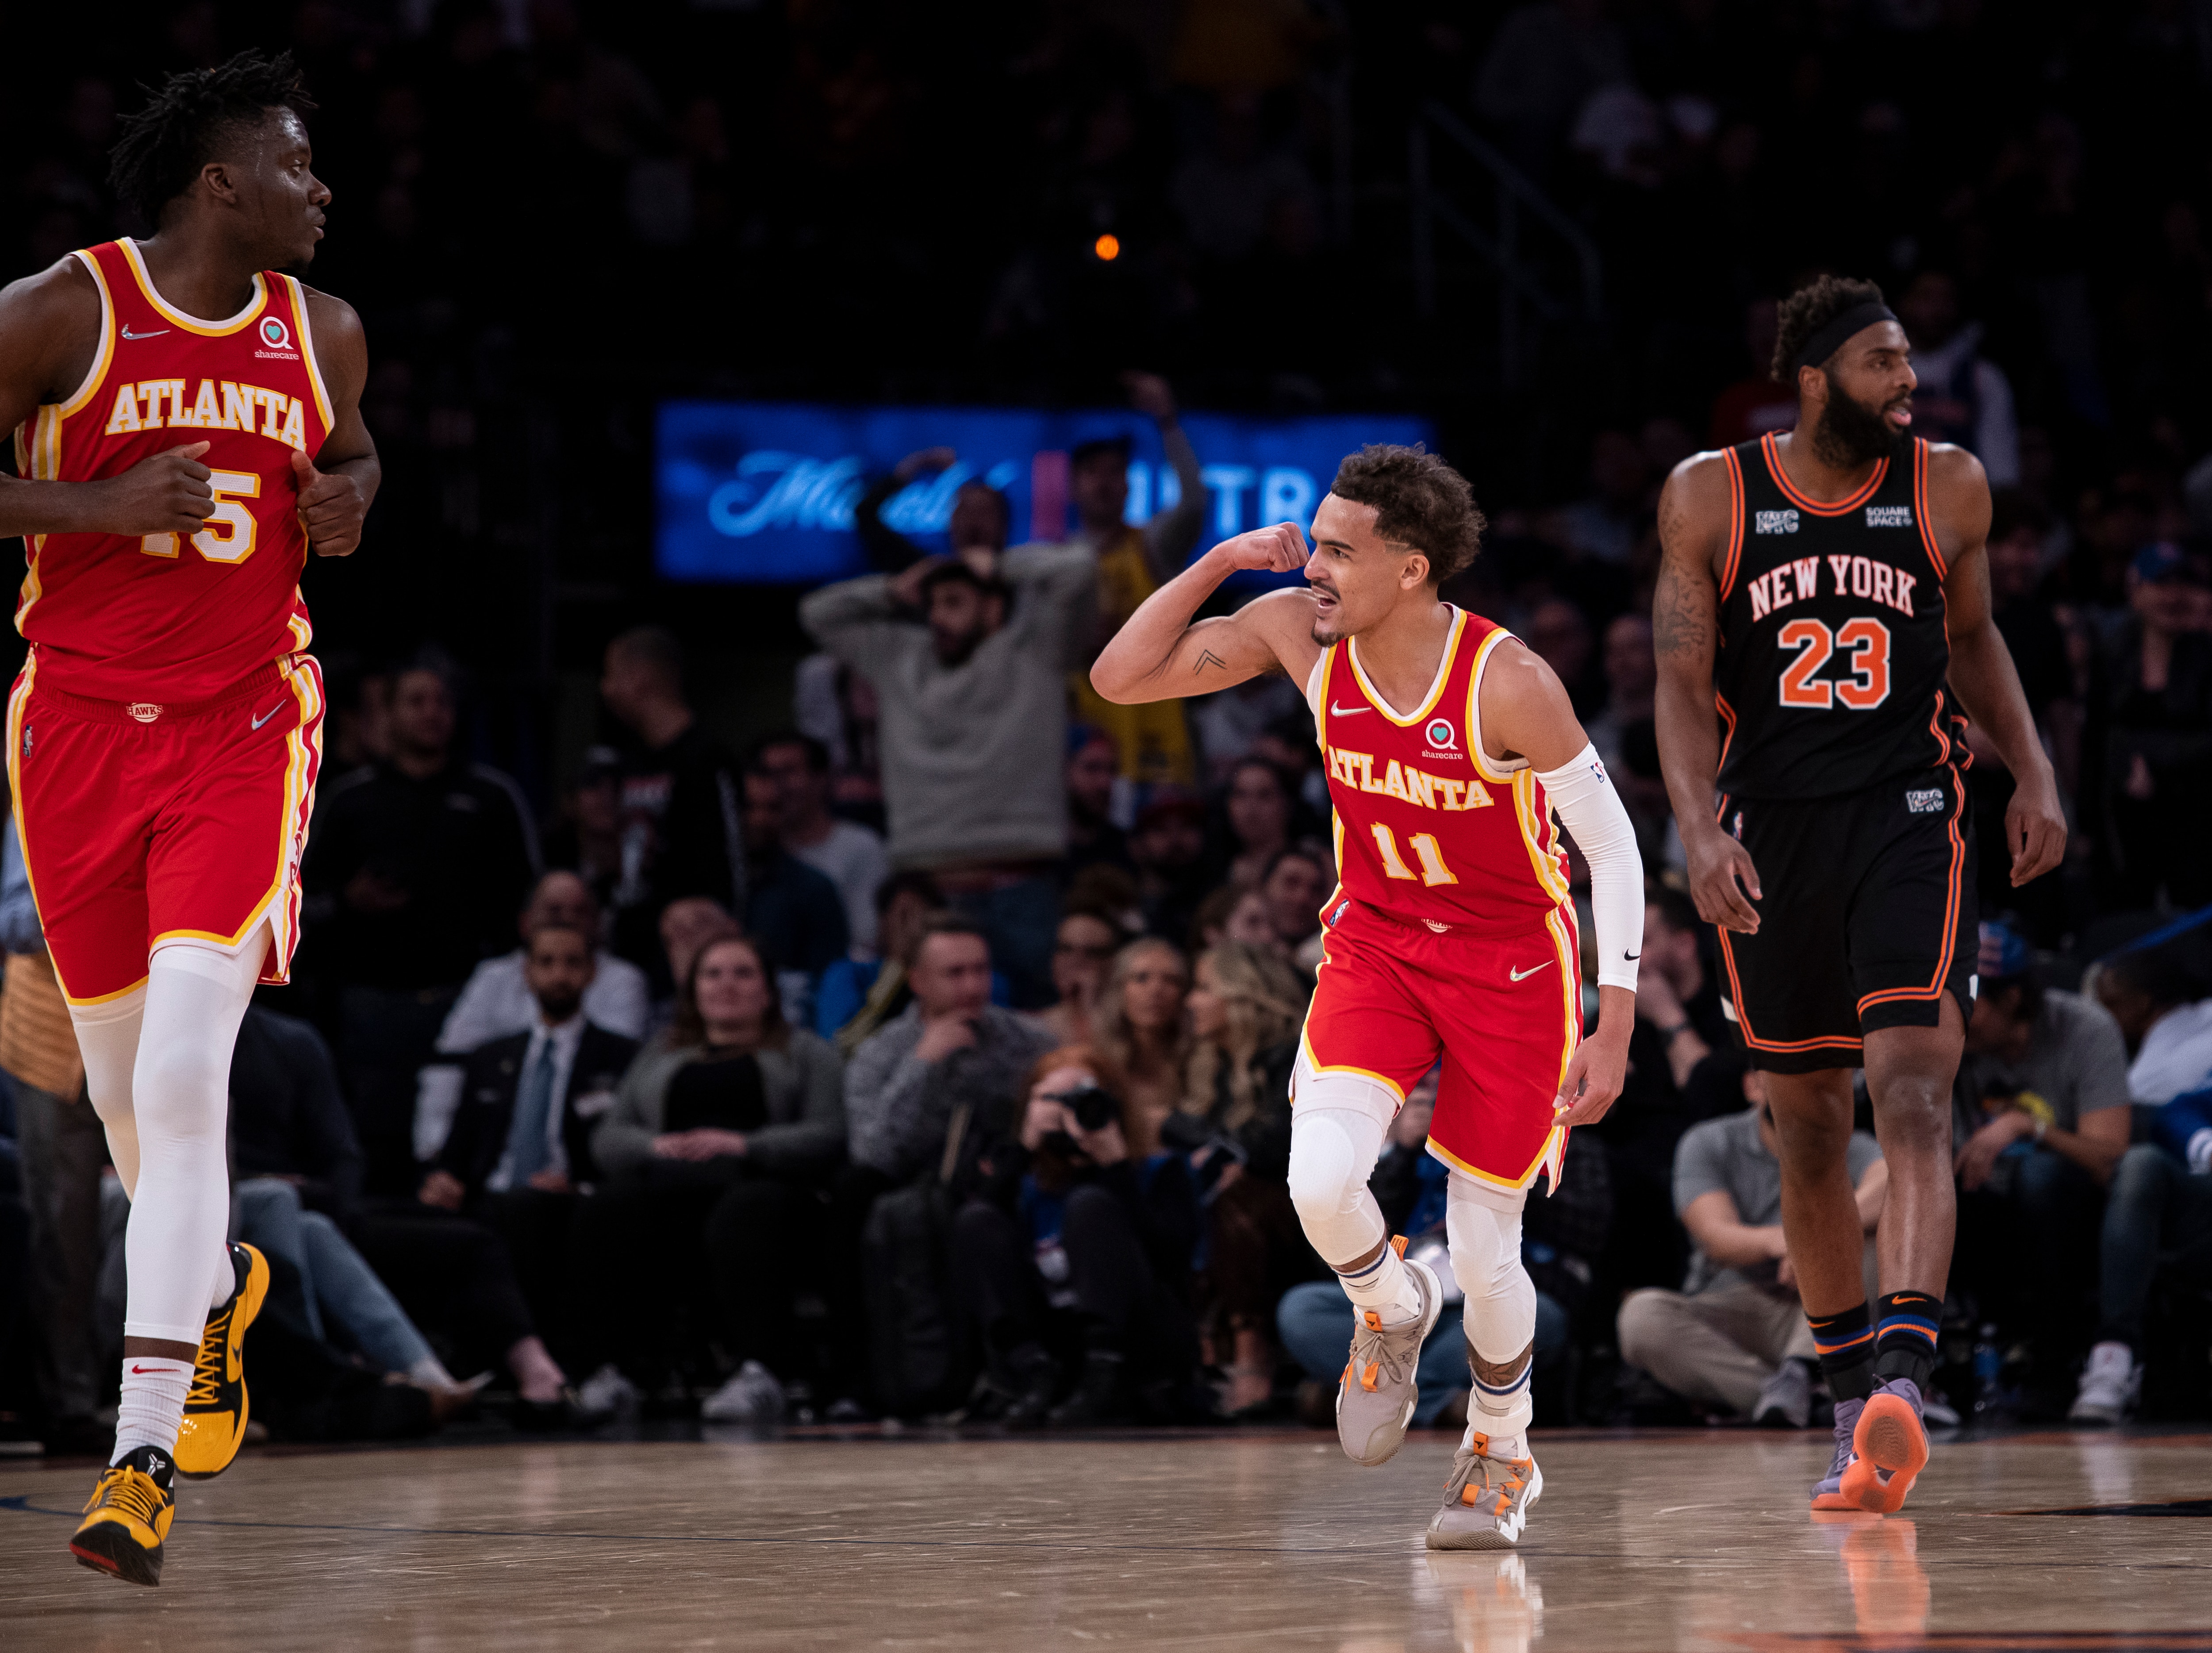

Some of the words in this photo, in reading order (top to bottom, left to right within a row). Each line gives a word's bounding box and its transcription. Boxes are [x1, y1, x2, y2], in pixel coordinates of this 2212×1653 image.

[254, 349, 300, 360] sharecare
[105, 378, 307, 452] ATLANTA
[140, 468, 261, 564] 5
[1866, 507, 1910, 516] SQUARE
[1866, 516, 1903, 527] SPACE
[1748, 556, 1820, 622] NEW
[1828, 555, 1917, 618] YORK
[1778, 618, 1890, 709] 23
[127, 706, 163, 715] HAWKS
[1421, 749, 1463, 759] sharecare
[1371, 821, 1459, 887] 11
